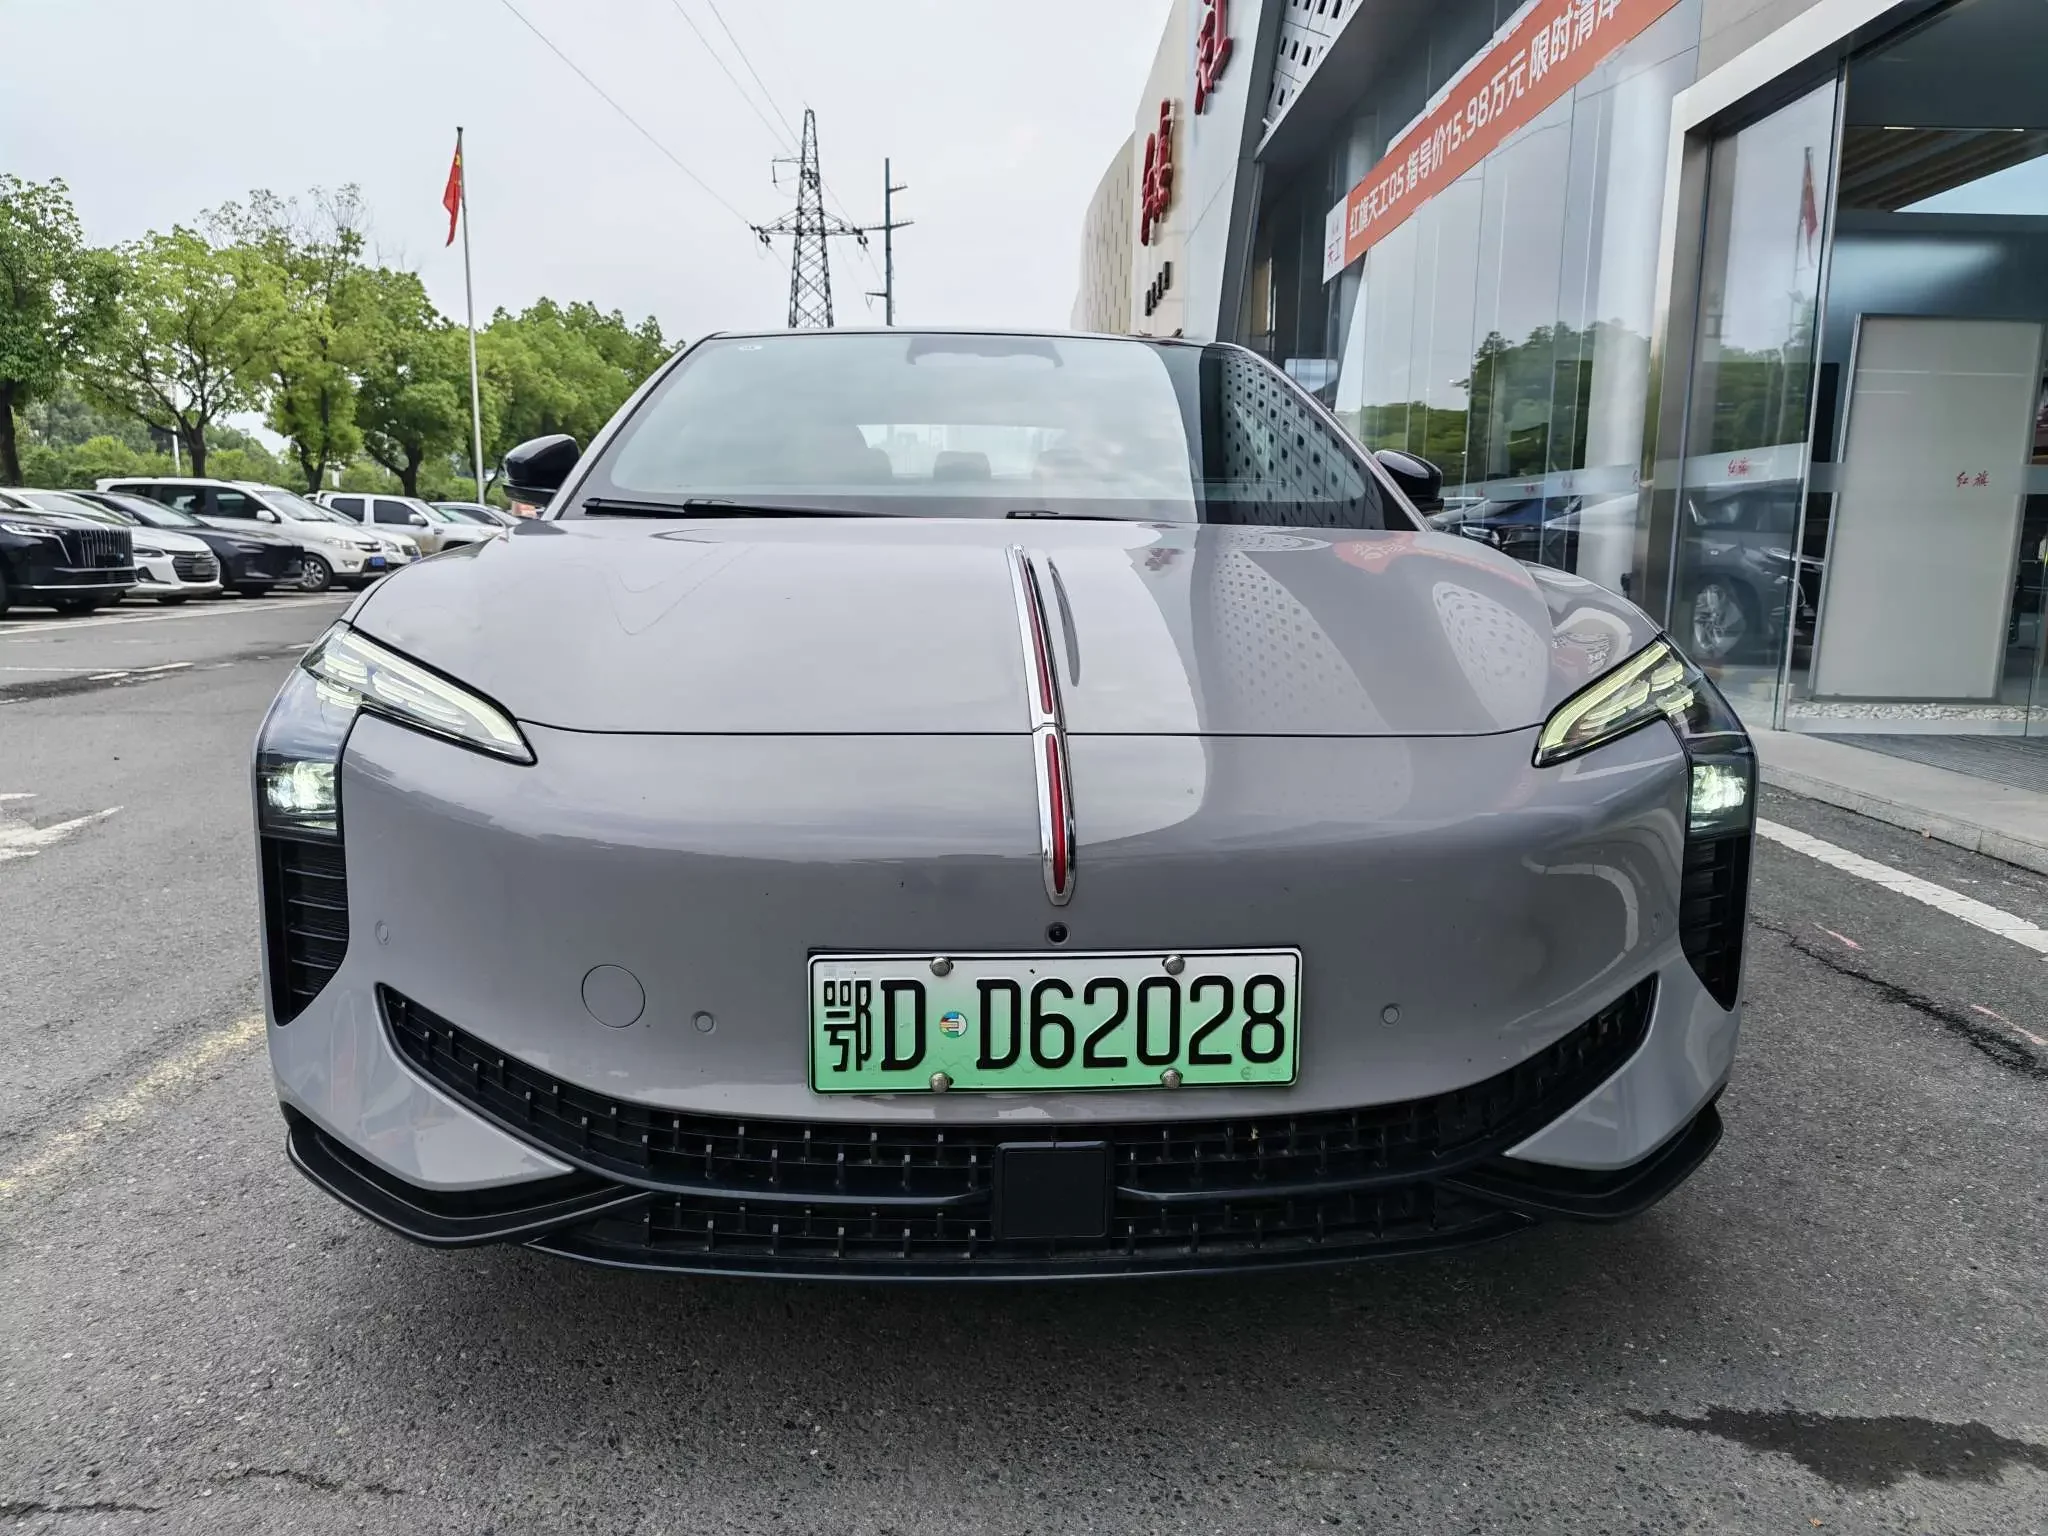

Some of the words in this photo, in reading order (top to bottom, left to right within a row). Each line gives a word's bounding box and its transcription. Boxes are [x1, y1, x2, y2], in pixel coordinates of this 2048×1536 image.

[1349, 164, 1406, 241] 红旗天工05
[1406, 48, 1527, 194] 指导价15.98万元
[1956, 470, 1990, 488] 红旗
[975, 973, 1286, 1071] D62028
